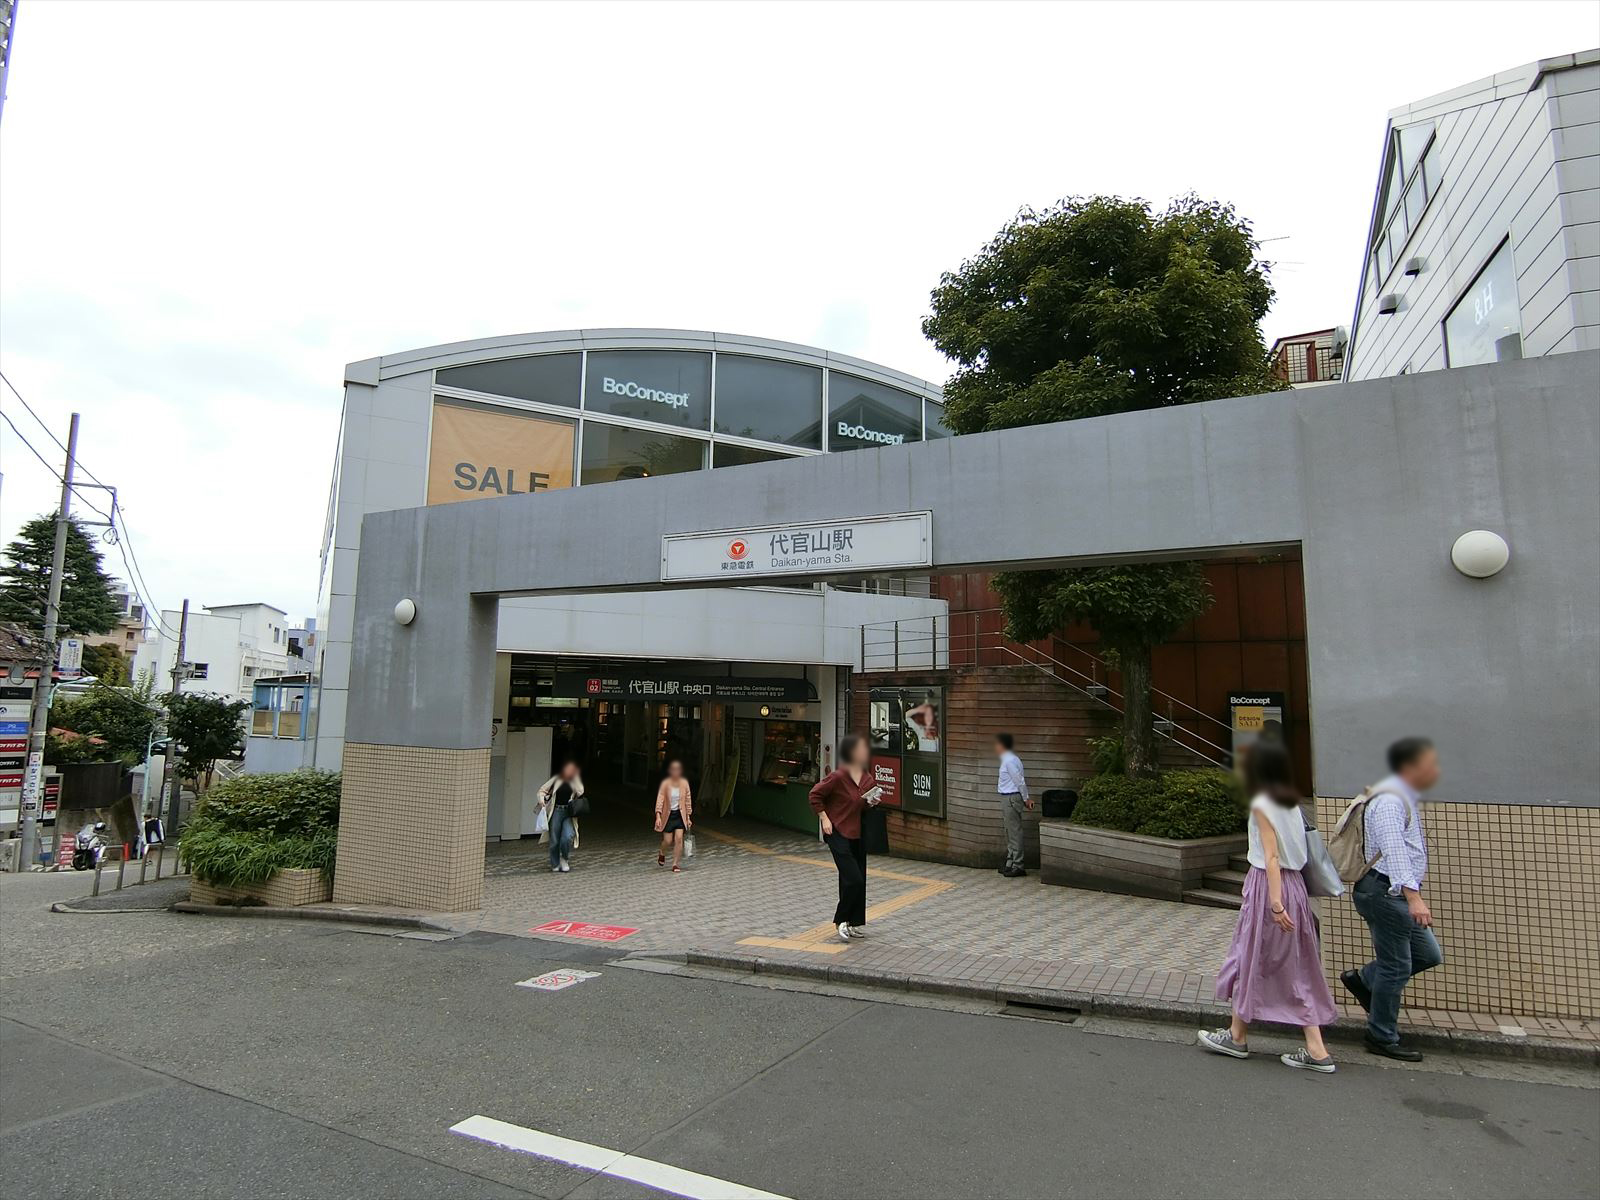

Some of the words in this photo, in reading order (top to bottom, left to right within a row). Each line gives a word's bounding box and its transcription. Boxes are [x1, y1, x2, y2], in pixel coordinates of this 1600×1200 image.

[602, 376, 689, 409] BoConcept
[837, 421, 903, 446] BoConcept
[769, 528, 853, 556] 代官山駅
[720, 560, 754, 571] 東急電鉄
[771, 556, 831, 568] Daikan-yama
[834, 553, 853, 563] Sta.
[589, 684, 599, 692] 02
[628, 679, 680, 695] 代官山駅
[682, 684, 712, 695] 中央口
[1230, 696, 1270, 705] BoConcept
[913, 773, 931, 790] SIGN
[913, 789, 931, 797] ALLDAY
